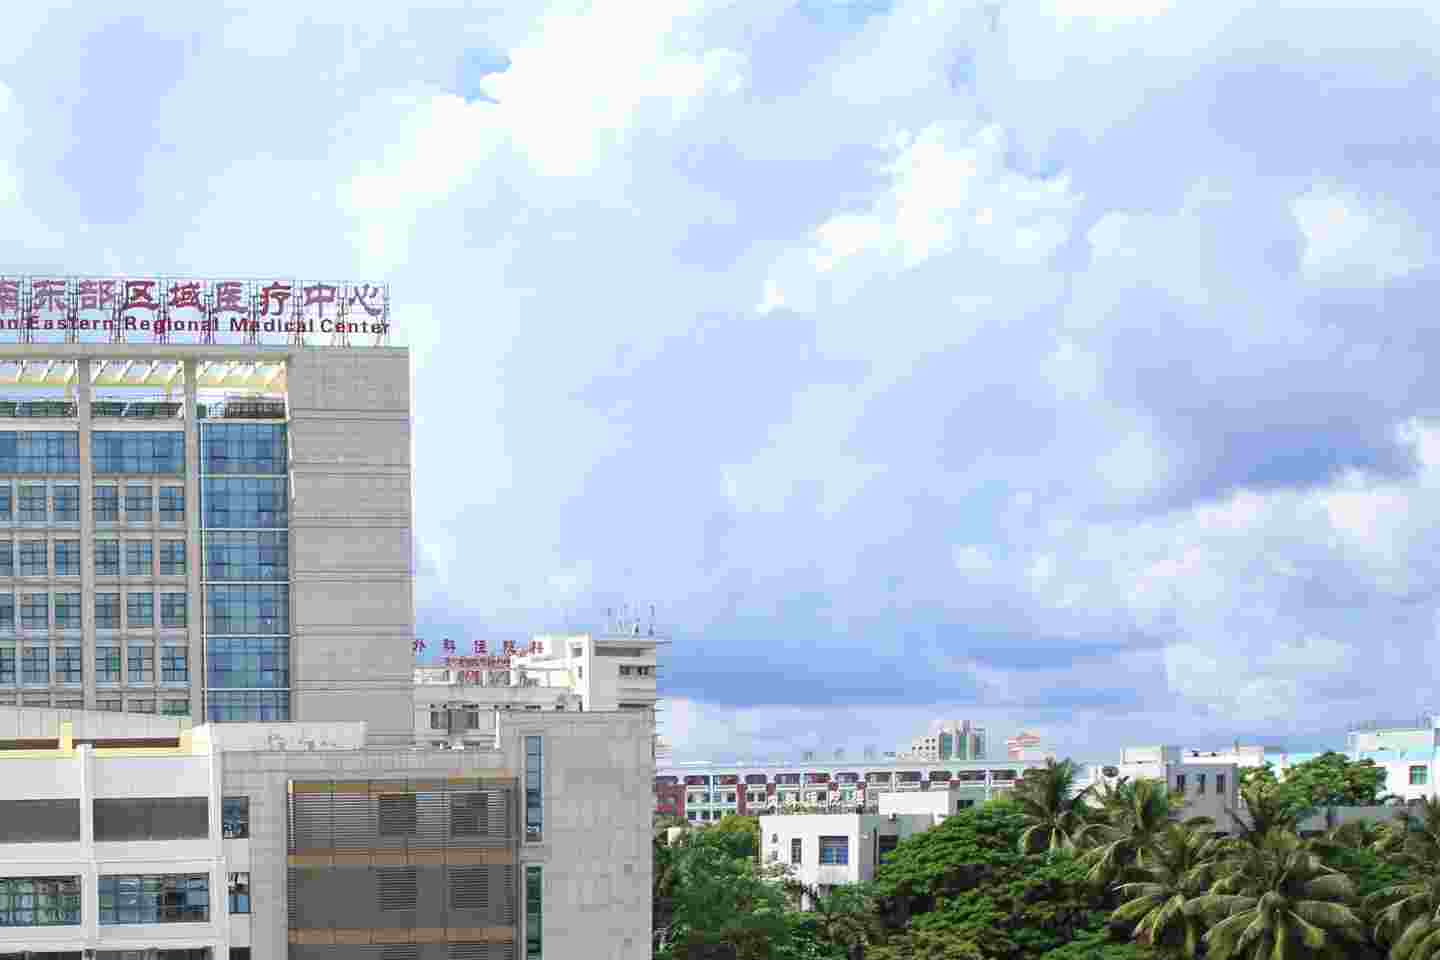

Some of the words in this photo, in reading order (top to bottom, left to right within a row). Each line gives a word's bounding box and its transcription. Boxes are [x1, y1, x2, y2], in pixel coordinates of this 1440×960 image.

[30, 315, 114, 330] Eastern
[125, 315, 219, 334] Regional
[229, 317, 313, 333] Medical
[320, 318, 389, 334] Center
